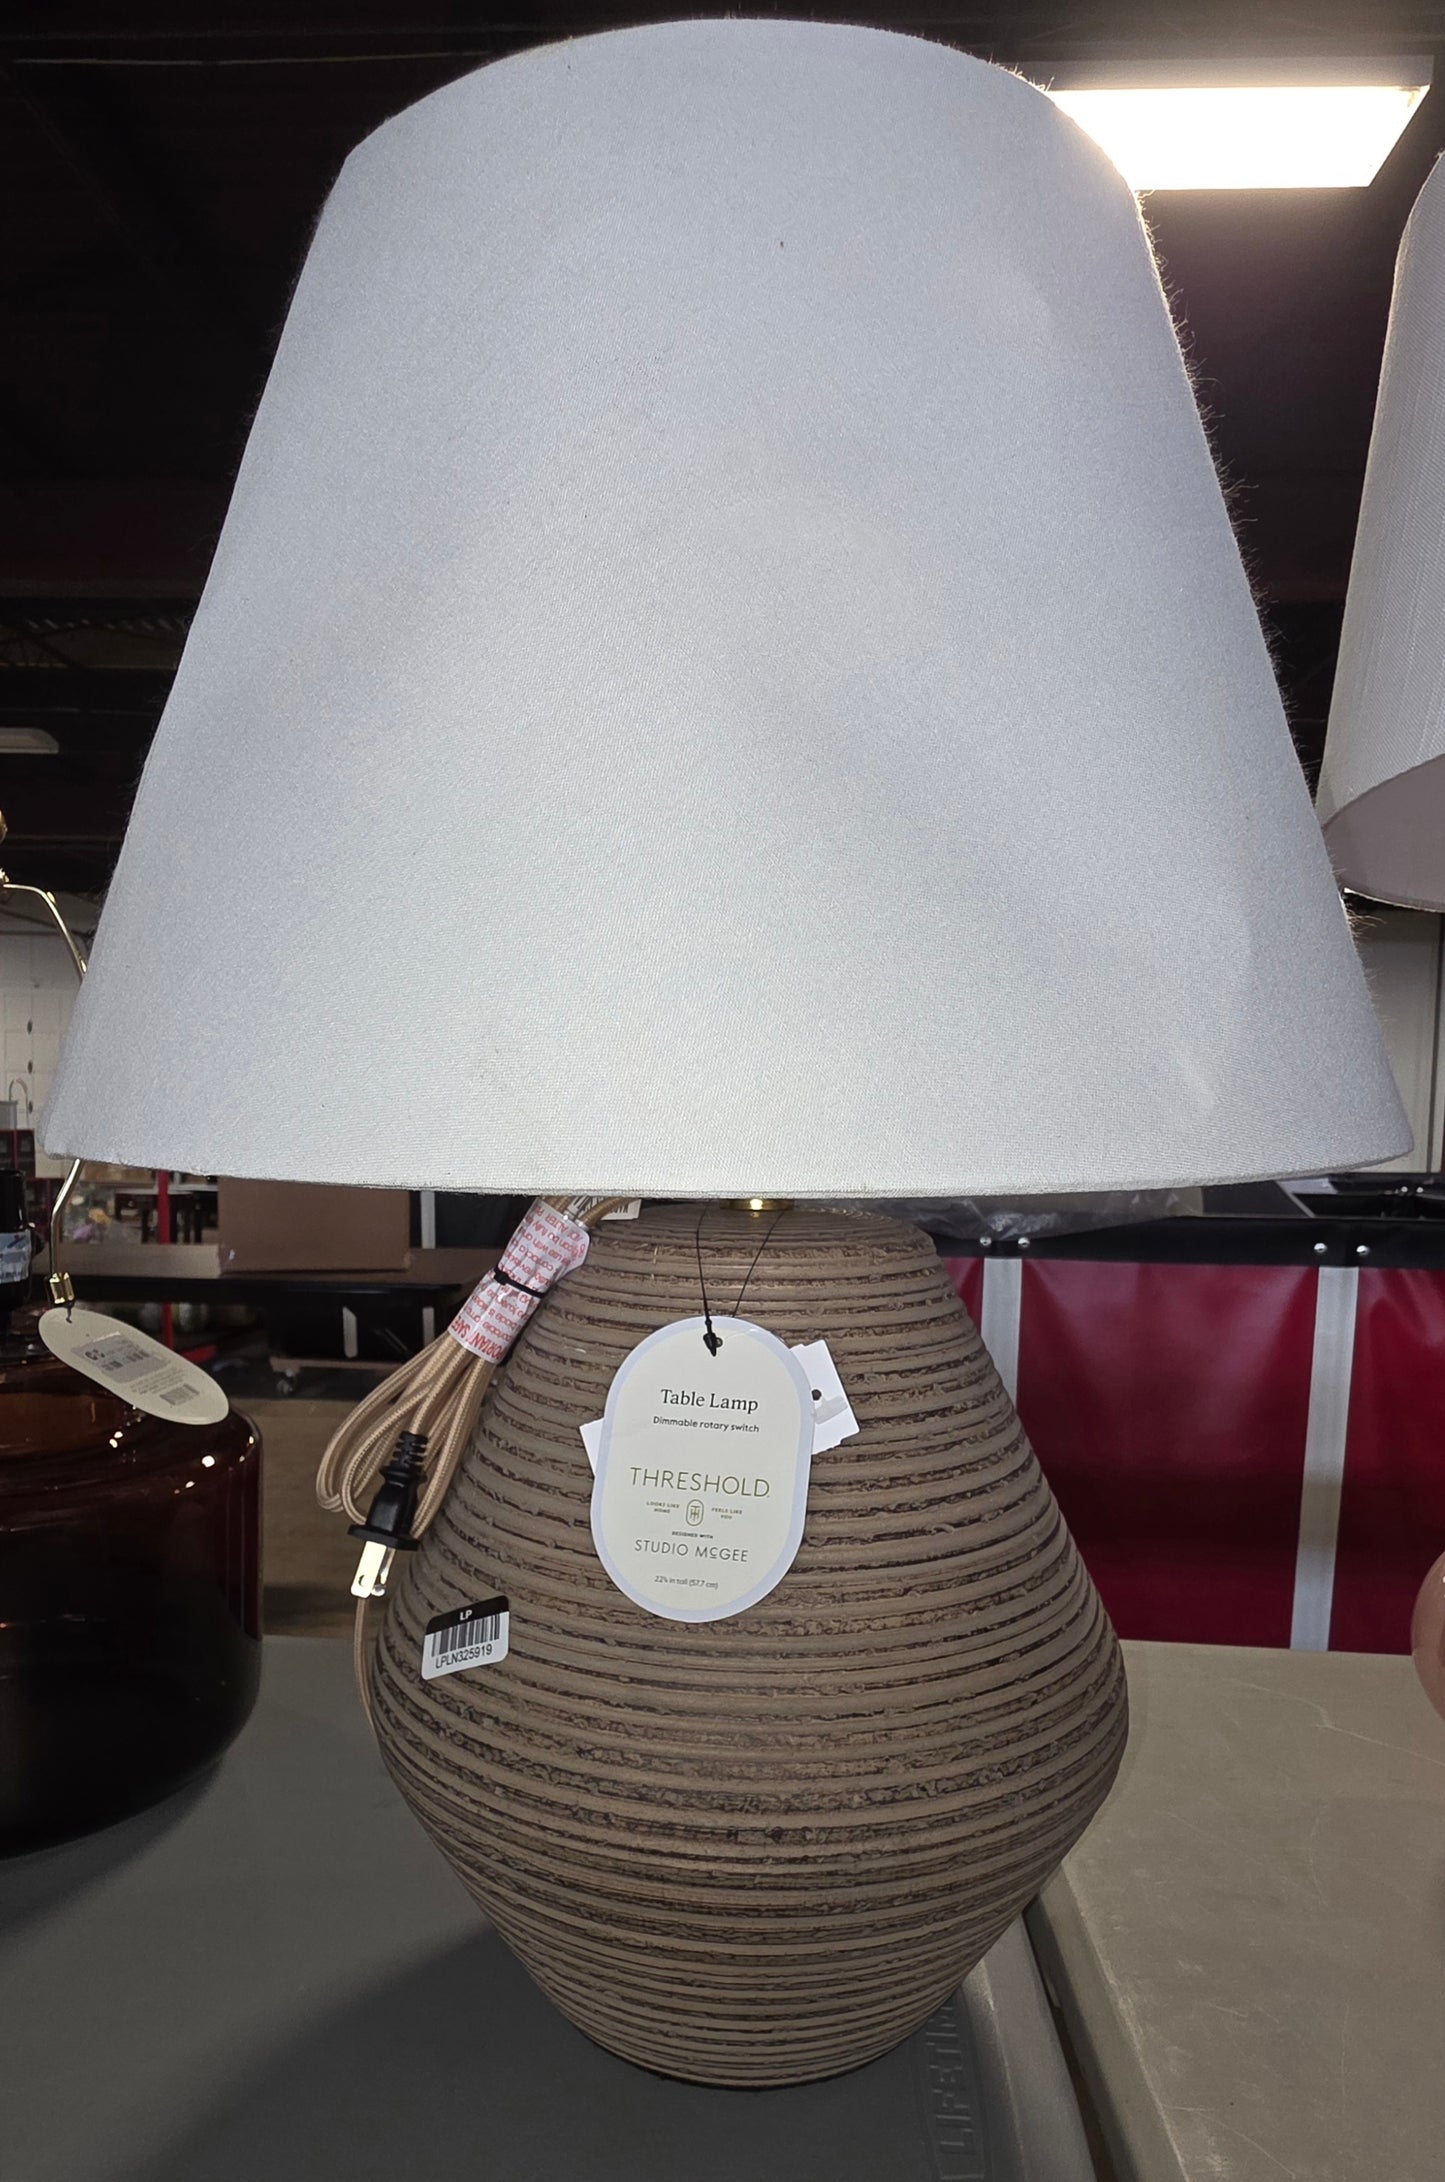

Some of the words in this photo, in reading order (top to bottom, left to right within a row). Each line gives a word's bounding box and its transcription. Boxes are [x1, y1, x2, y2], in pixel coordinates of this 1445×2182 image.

[660, 1388, 705, 1407] Table
[709, 1392, 759, 1415] Lamp
[652, 1415, 698, 1428] Dimmable
[699, 1420, 729, 1432] rotary
[730, 1423, 760, 1433] switch
[630, 1466, 770, 1498] THRESHOLD
[634, 1539, 689, 1557] STUDIO
[460, 1609, 472, 1620] LP
[435, 1643, 493, 1669] LPLN325919
